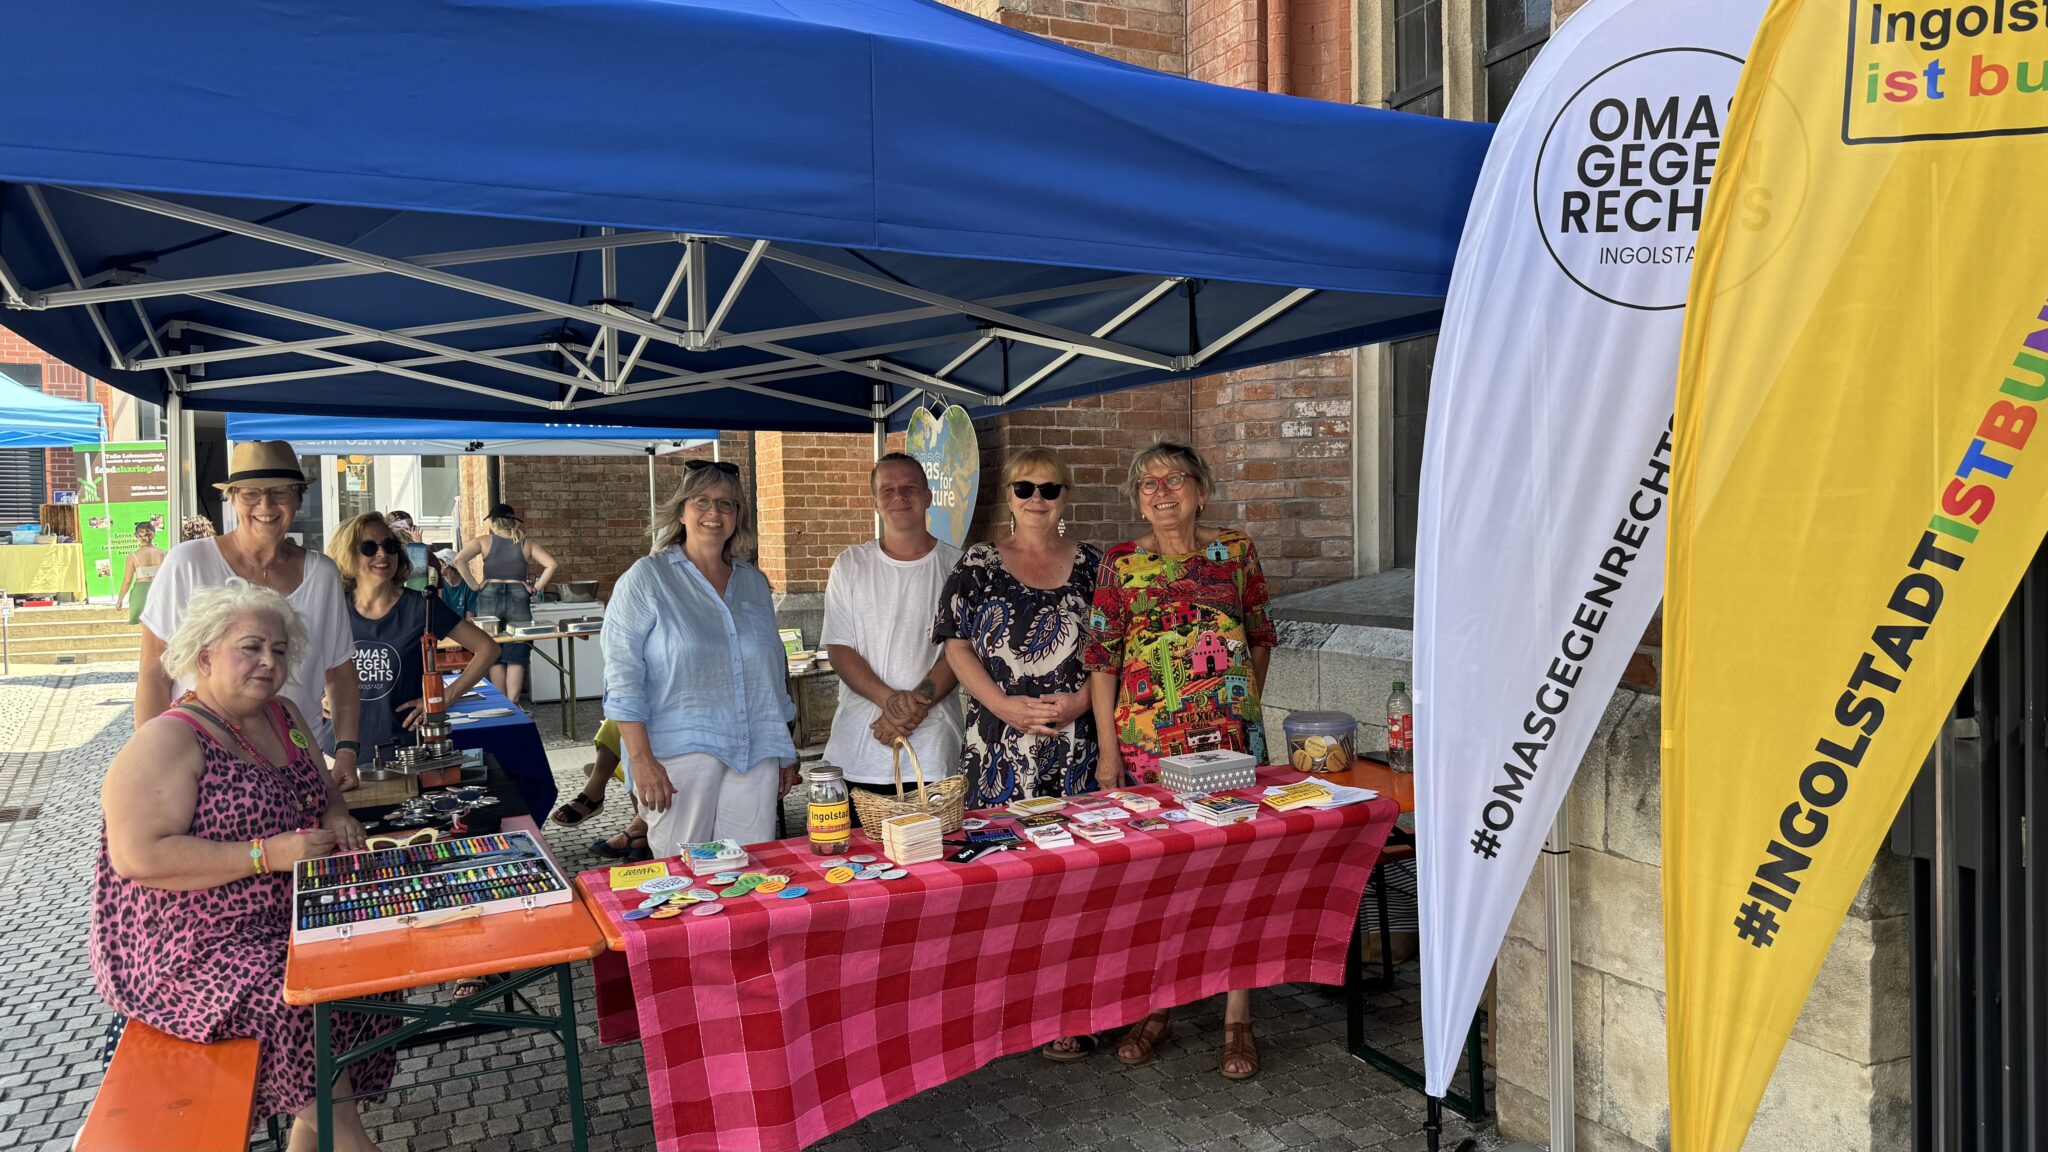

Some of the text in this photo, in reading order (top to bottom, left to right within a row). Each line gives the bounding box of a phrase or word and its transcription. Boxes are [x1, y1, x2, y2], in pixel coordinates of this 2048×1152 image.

[1866, 54, 2048, 104] ist bu
[1588, 95, 1735, 142] OMA
[1599, 246, 1696, 265] INGOLSTA
[940, 472, 953, 489] for
[932, 486, 955, 507] ture
[1470, 411, 1676, 859] #OMASGEGENRECHT
[352, 658, 390, 671] EGEN
[358, 670, 394, 682] CHTS
